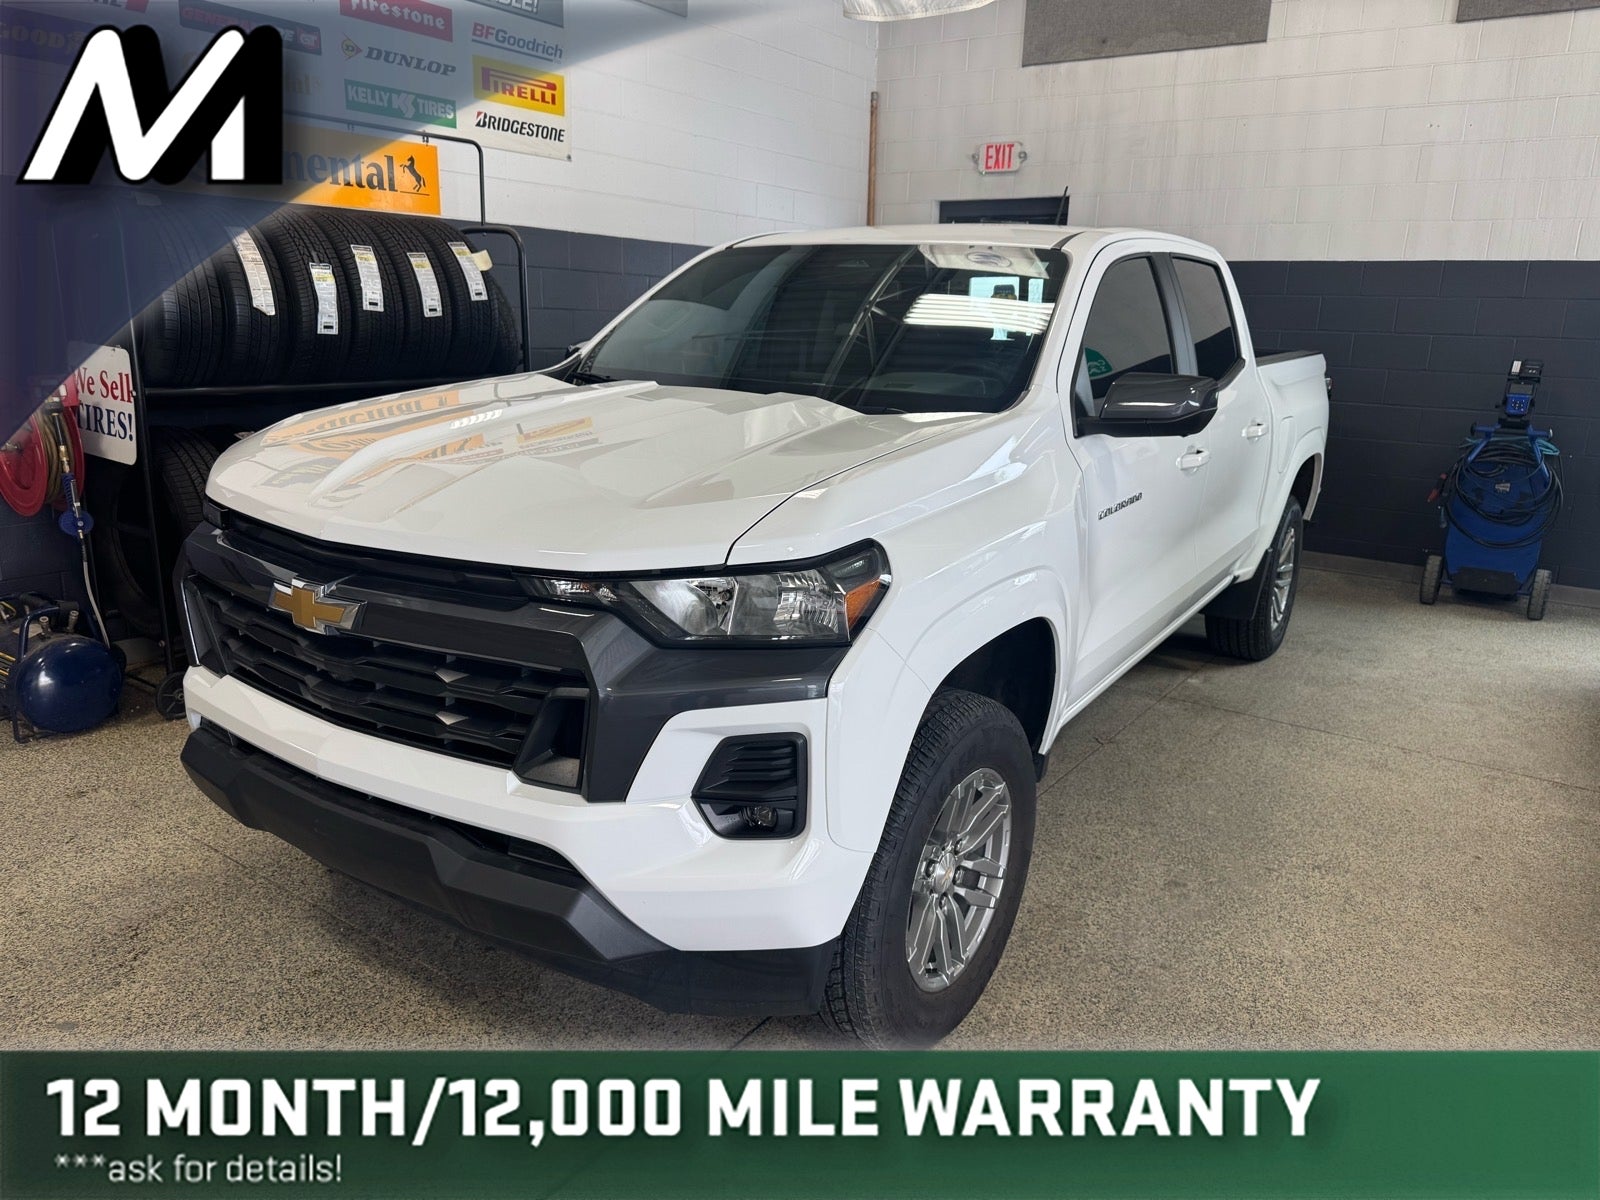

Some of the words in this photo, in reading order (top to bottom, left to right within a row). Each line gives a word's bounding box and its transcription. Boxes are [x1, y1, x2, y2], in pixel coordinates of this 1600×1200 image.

[471, 21, 563, 59] BFGoodrich
[365, 46, 457, 76] DUNLOP
[346, 85, 390, 108] KELLY
[416, 98, 455, 119] TIRES
[481, 66, 558, 106] PIRELLI
[475, 111, 566, 142] BRIDGESTONE
[283, 150, 399, 192] nental
[985, 143, 1015, 170] EXIT
[100, 370, 133, 404] Sell
[77, 402, 133, 442] TIRES!
[1097, 492, 1143, 520] COLORADO
